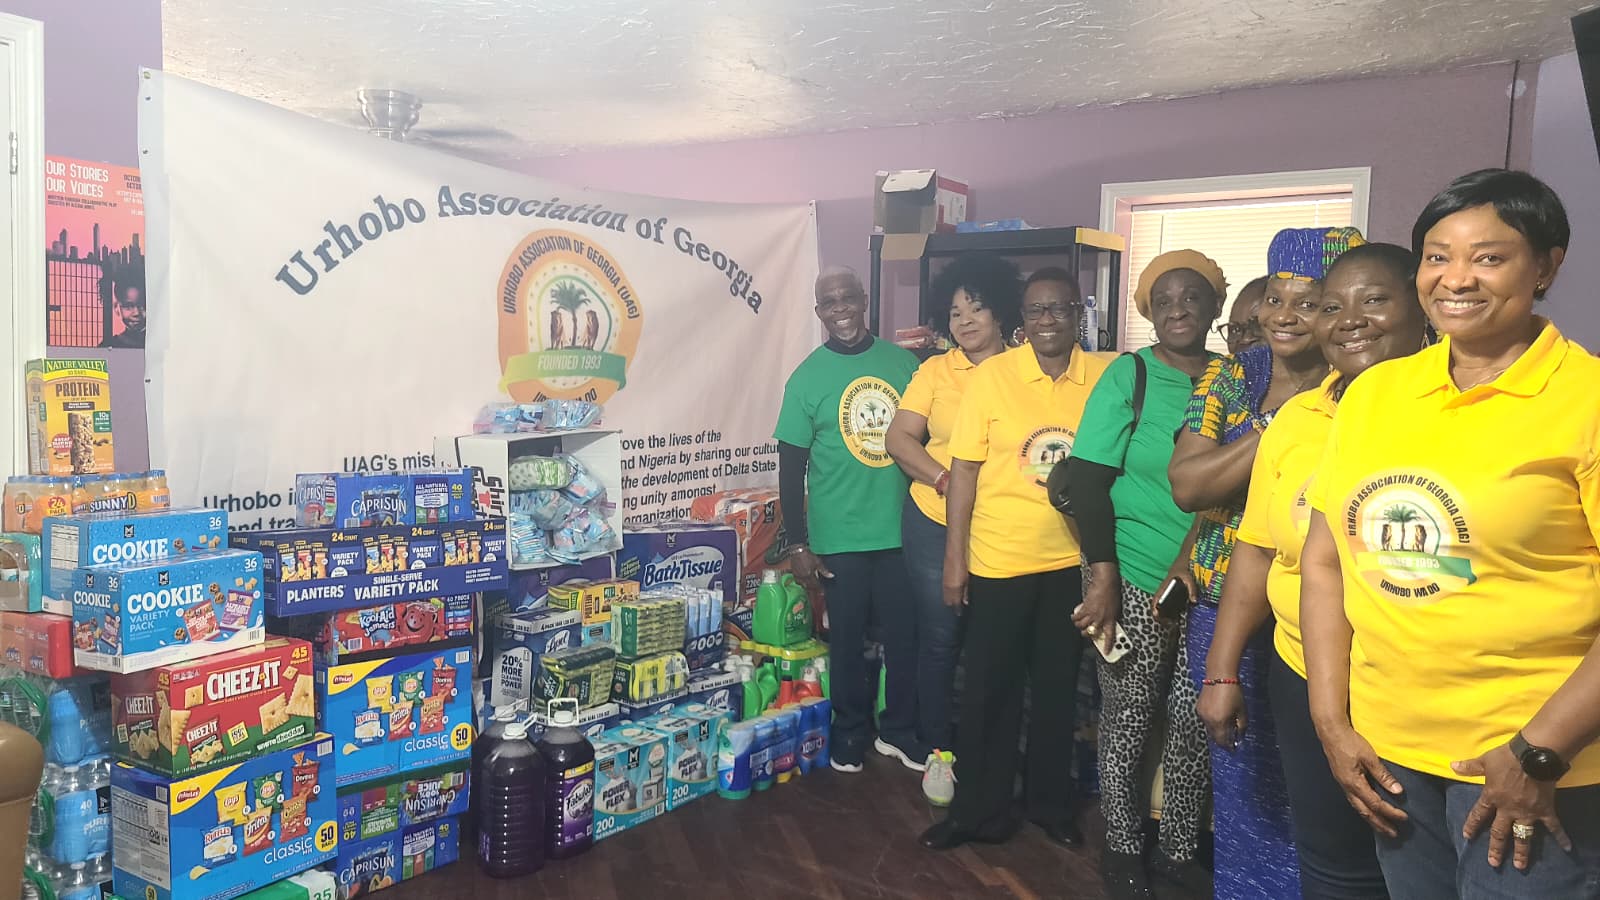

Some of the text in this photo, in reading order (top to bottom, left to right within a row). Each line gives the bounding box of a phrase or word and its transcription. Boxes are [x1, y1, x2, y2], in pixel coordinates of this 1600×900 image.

[46, 160, 110, 183] OUR STORIES
[46, 177, 66, 193] OUR
[70, 180, 104, 200] VOICES
[275, 184, 762, 315] Urhobo Association of Georgia
[503, 235, 641, 320] URHOBO ASSOCIATION OF GEORGIA (UAG)
[46, 360, 106, 372] NATURE VALLEY
[537, 354, 602, 370] FOUNDED 1993
[56, 381, 101, 397] PROTEIN
[846, 382, 872, 411] ASSOCIATION
[873, 383, 882, 391] OF
[621, 429, 722, 452] ove the lives of the
[343, 454, 398, 473] UAG's
[621, 442, 779, 474] nd Nigeria by sharing our cultur
[859, 449, 882, 462] URHOBO
[621, 459, 777, 493] the development of Delta State
[451, 483, 462, 491] 40
[48, 497, 66, 508] 24
[203, 490, 282, 513] Urhobo
[622, 484, 717, 512] ng unity amongst
[623, 506, 691, 524] organization
[1347, 473, 1471, 545] URHOBO ASSOCIATION OF GEORGIA (UAG)
[209, 516, 222, 527] 36
[268, 517, 297, 530] tra
[484, 522, 494, 531] 24
[332, 532, 344, 542] 24
[412, 526, 424, 537] 24
[92, 538, 168, 563] COOKIE
[332, 551, 359, 560] VARIETY
[412, 545, 437, 553] VARIETY
[416, 551, 433, 559] PACK
[245, 557, 258, 569] 36
[337, 558, 354, 567] PACK
[1414, 559, 1441, 569] 1993
[373, 571, 424, 585] SINGLE-SERVE
[644, 558, 681, 587] Bath
[679, 558, 723, 580] Tissue
[107, 576, 119, 588] 36
[1379, 578, 1441, 598] URHOBO WA DO
[73, 590, 112, 609] COOKIE
[127, 583, 204, 614] COOKIE
[286, 578, 440, 605] PLANTERS VARIETY PACK
[129, 610, 170, 628] VARIETY
[359, 604, 396, 628] Kool-Aid
[129, 623, 154, 636] PACK
[364, 619, 396, 636] Jammers
[290, 650, 309, 664] 45
[502, 654, 524, 668] 20%
[158, 672, 169, 687] 45
[501, 665, 523, 679] MORE
[501, 679, 523, 691] POWER
[404, 733, 449, 753] classic
[455, 727, 468, 742] 50
[678, 752, 701, 770] POWER
[681, 763, 698, 779] FLEX
[602, 780, 630, 801] POWER
[672, 784, 689, 801] 200
[81, 800, 93, 811] 40
[605, 791, 627, 810] FLEX
[83, 818, 109, 835] PURI
[595, 816, 615, 835] 200
[320, 825, 334, 844] 50
[264, 836, 314, 865] classic
[314, 887, 333, 900] 35
